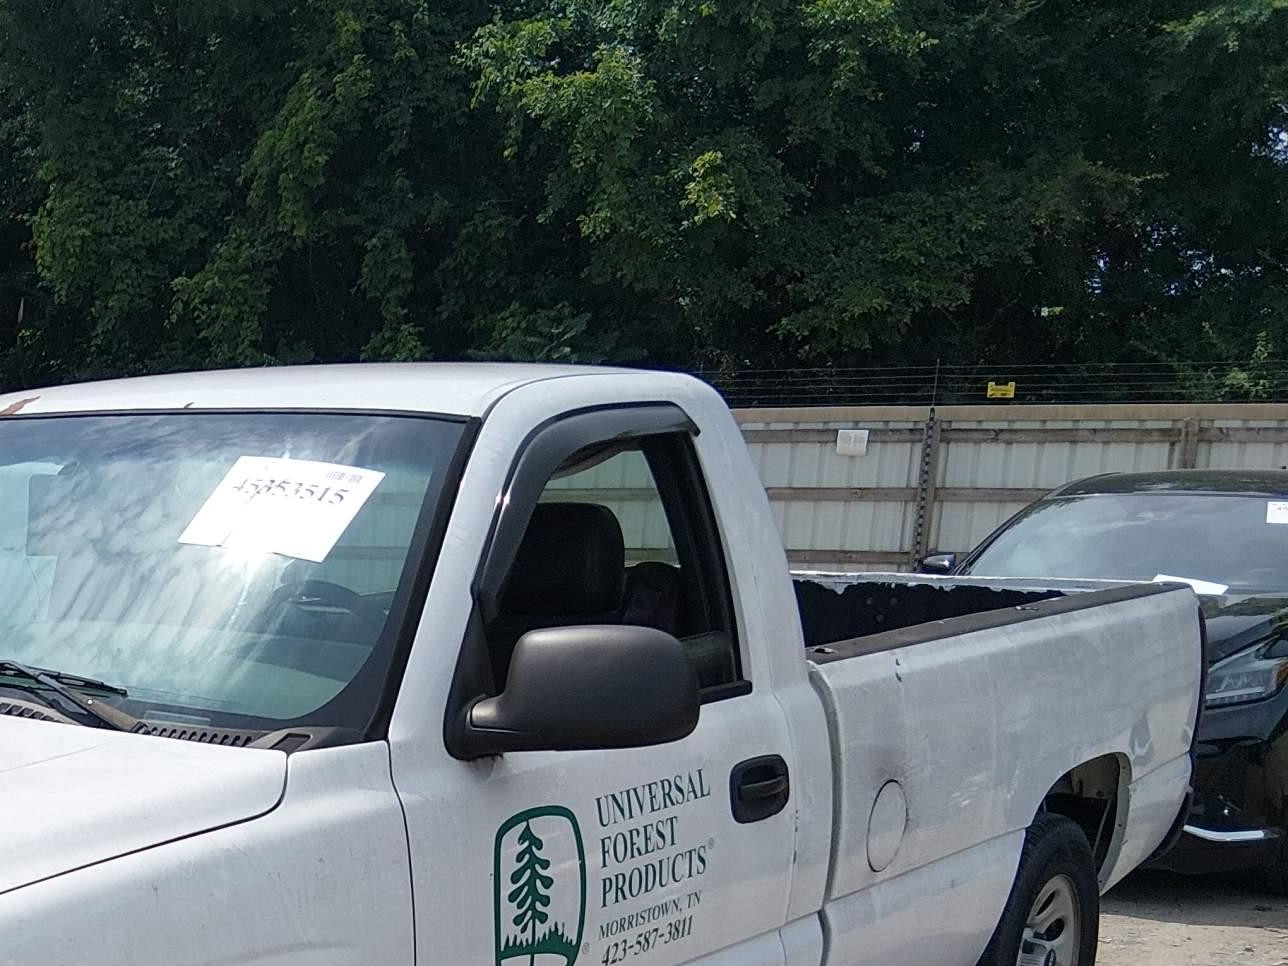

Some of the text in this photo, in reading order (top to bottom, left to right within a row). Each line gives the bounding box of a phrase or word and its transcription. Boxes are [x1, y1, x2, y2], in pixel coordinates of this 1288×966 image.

[595, 768, 711, 828] UNIVERSAL
[600, 816, 678, 869] FOREST
[598, 890, 702, 941] MORRISTOWN, TN
[601, 915, 694, 966] 423-587-3811
